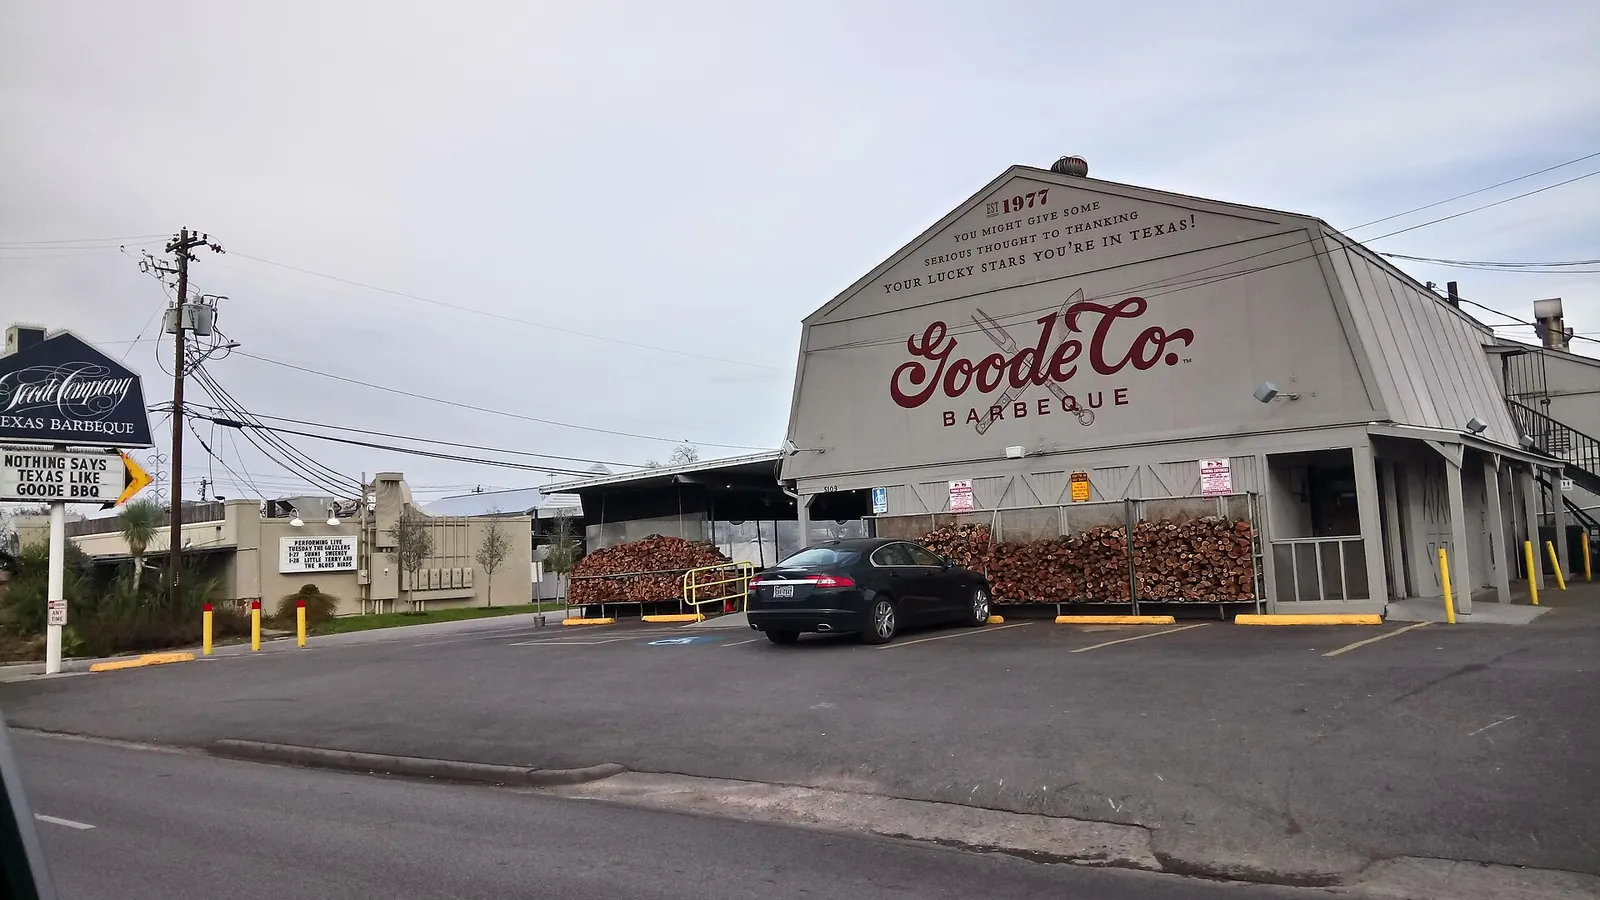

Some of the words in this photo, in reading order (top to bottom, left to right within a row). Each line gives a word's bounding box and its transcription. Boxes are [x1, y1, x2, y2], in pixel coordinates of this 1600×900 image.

[986, 201, 999, 214] EST
[1002, 188, 1050, 214] 1977
[954, 230, 977, 243] YOU
[982, 219, 1022, 237] MIGHT
[1027, 212, 1058, 225] GIVE
[1063, 201, 1101, 217] SOME
[884, 277, 922, 294] YOUR
[927, 265, 974, 285] LUCKY
[981, 254, 1026, 273] STARS
[1033, 240, 1095, 262] YOU'RE
[1102, 233, 1122, 248] IN
[1130, 214, 1195, 241] TEXAS!
[924, 249, 972, 267] SERIOUS
[977, 234, 1037, 254] THOUGHT
[1042, 229, 1060, 240] TO
[1065, 211, 1139, 235] THANKING
[890, 311, 1083, 409] Goode
[1064, 296, 1194, 376] Co.
[942, 387, 1129, 427] BARBEQUE
[0, 415, 44, 430] EXAS
[50, 418, 135, 435] BARBEQUE
[4, 454, 66, 469] NOTHING
[70, 457, 107, 471] SAYS
[18, 469, 64, 483] TEXAS
[70, 471, 100, 484] LIKE
[17, 483, 64, 497] GOODE
[70, 485, 100, 497] BBQ
